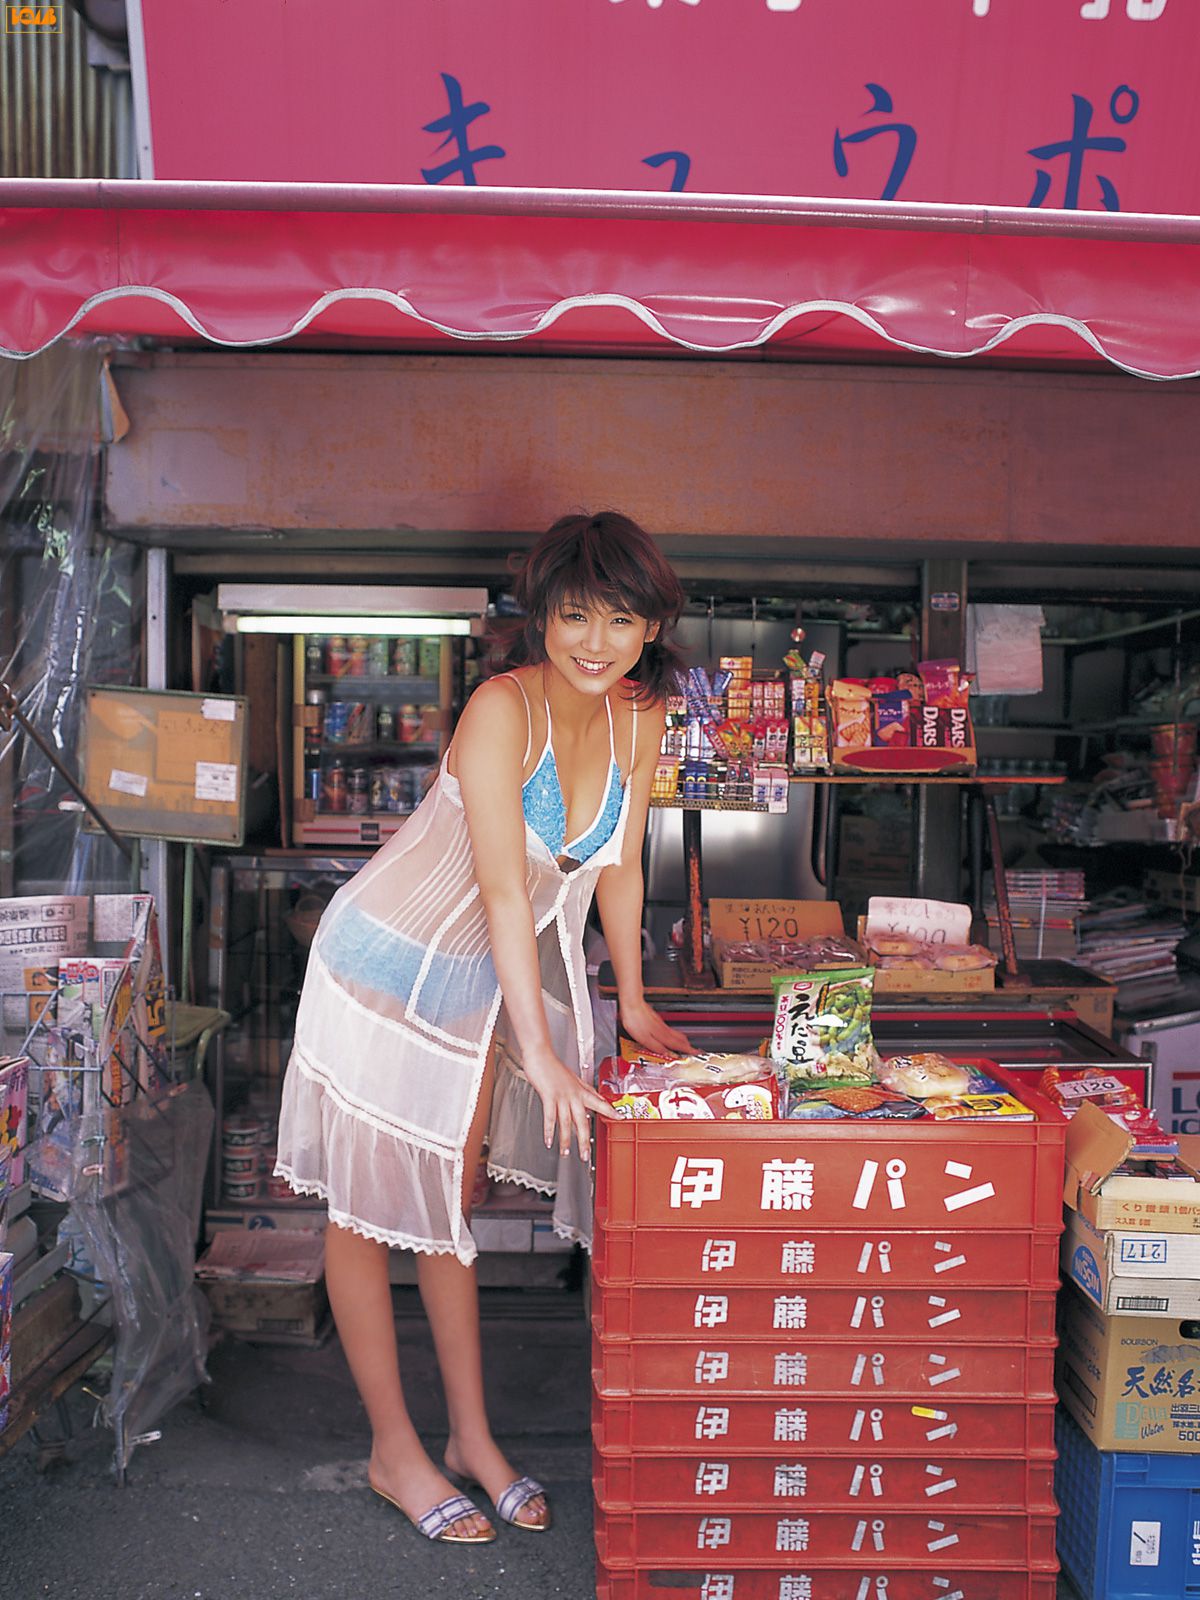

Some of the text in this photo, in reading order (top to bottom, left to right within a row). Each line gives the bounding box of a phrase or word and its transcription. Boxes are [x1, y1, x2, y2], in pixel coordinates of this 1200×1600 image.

[923, 706, 939, 746] DARS
[950, 708, 967, 748] DARS
[739, 916, 799, 940] ¥120
[787, 993, 815, 1064] えだ豆
[670, 1156, 995, 1212] 伊藤パン
[702, 1239, 966, 1274] 伊藤パン
[1127, 1243, 1161, 1259] 217
[695, 1295, 961, 1330] 伊藤パン
[1121, 1338, 1158, 1346] BOURBON
[695, 1351, 961, 1387] 伊藤パン
[1121, 1366, 1200, 1398] 天然名
[695, 1406, 958, 1442] 伊藤パン
[1171, 1404, 1200, 1412] 出羽三
[1140, 1423, 1165, 1439] Water
[1178, 1430, 1200, 1441] 500
[695, 1462, 957, 1497] 伊藤パン
[697, 1518, 960, 1553] 伊藤パン
